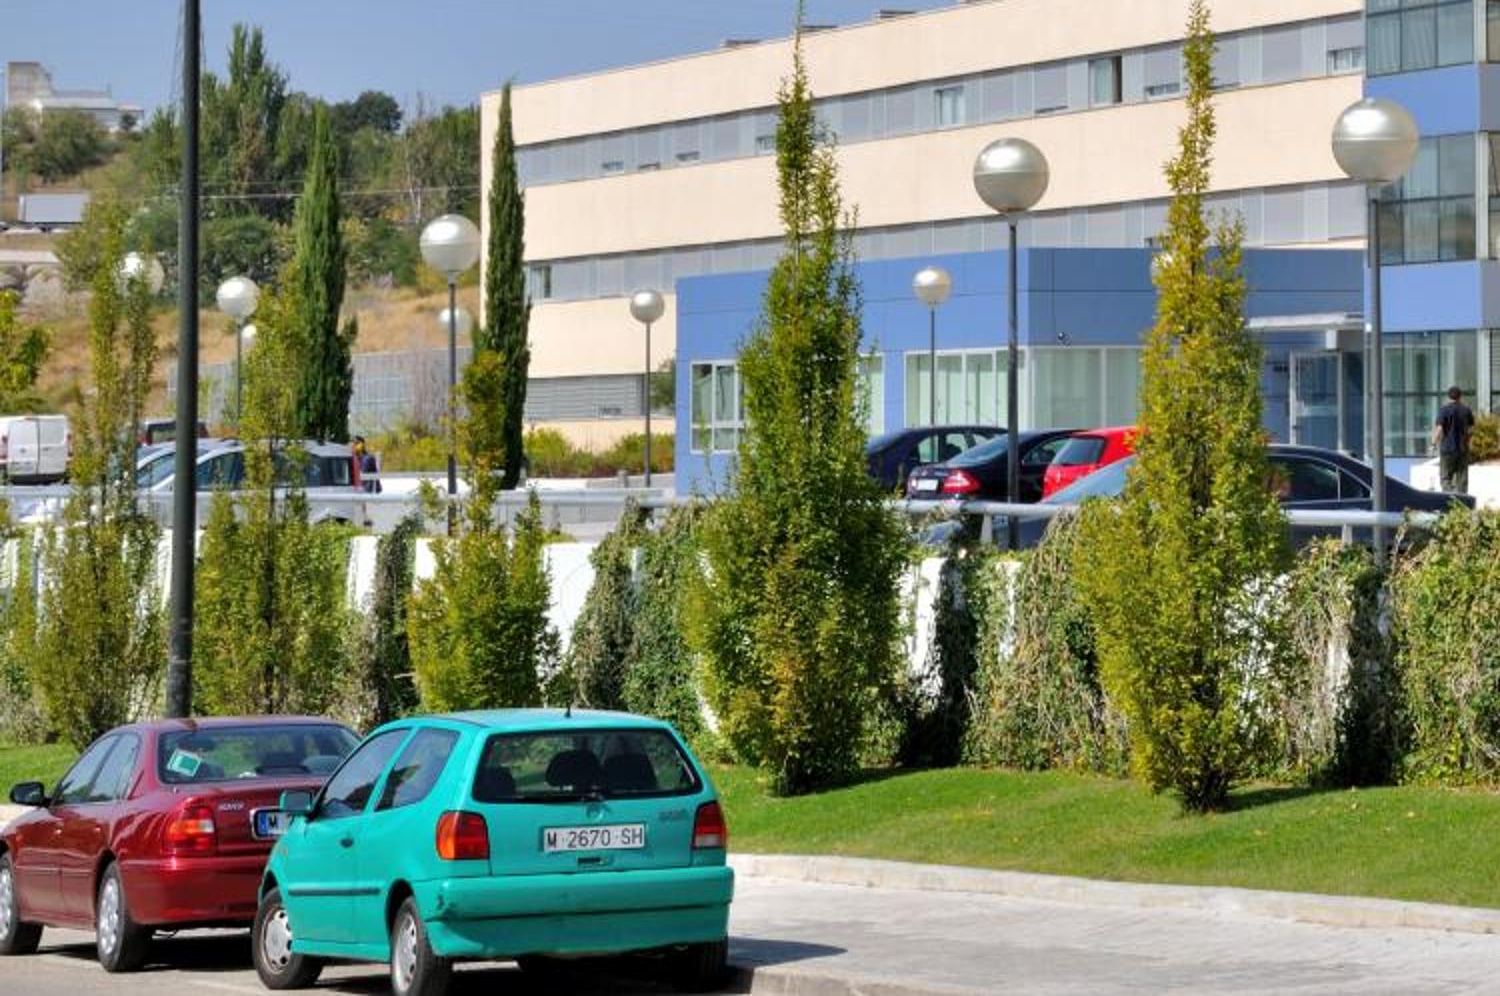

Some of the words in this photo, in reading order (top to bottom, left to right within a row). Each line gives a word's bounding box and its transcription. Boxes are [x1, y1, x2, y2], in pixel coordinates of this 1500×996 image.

[547, 832, 557, 848] M
[567, 829, 611, 848] 2670
[621, 827, 643, 845] SH
